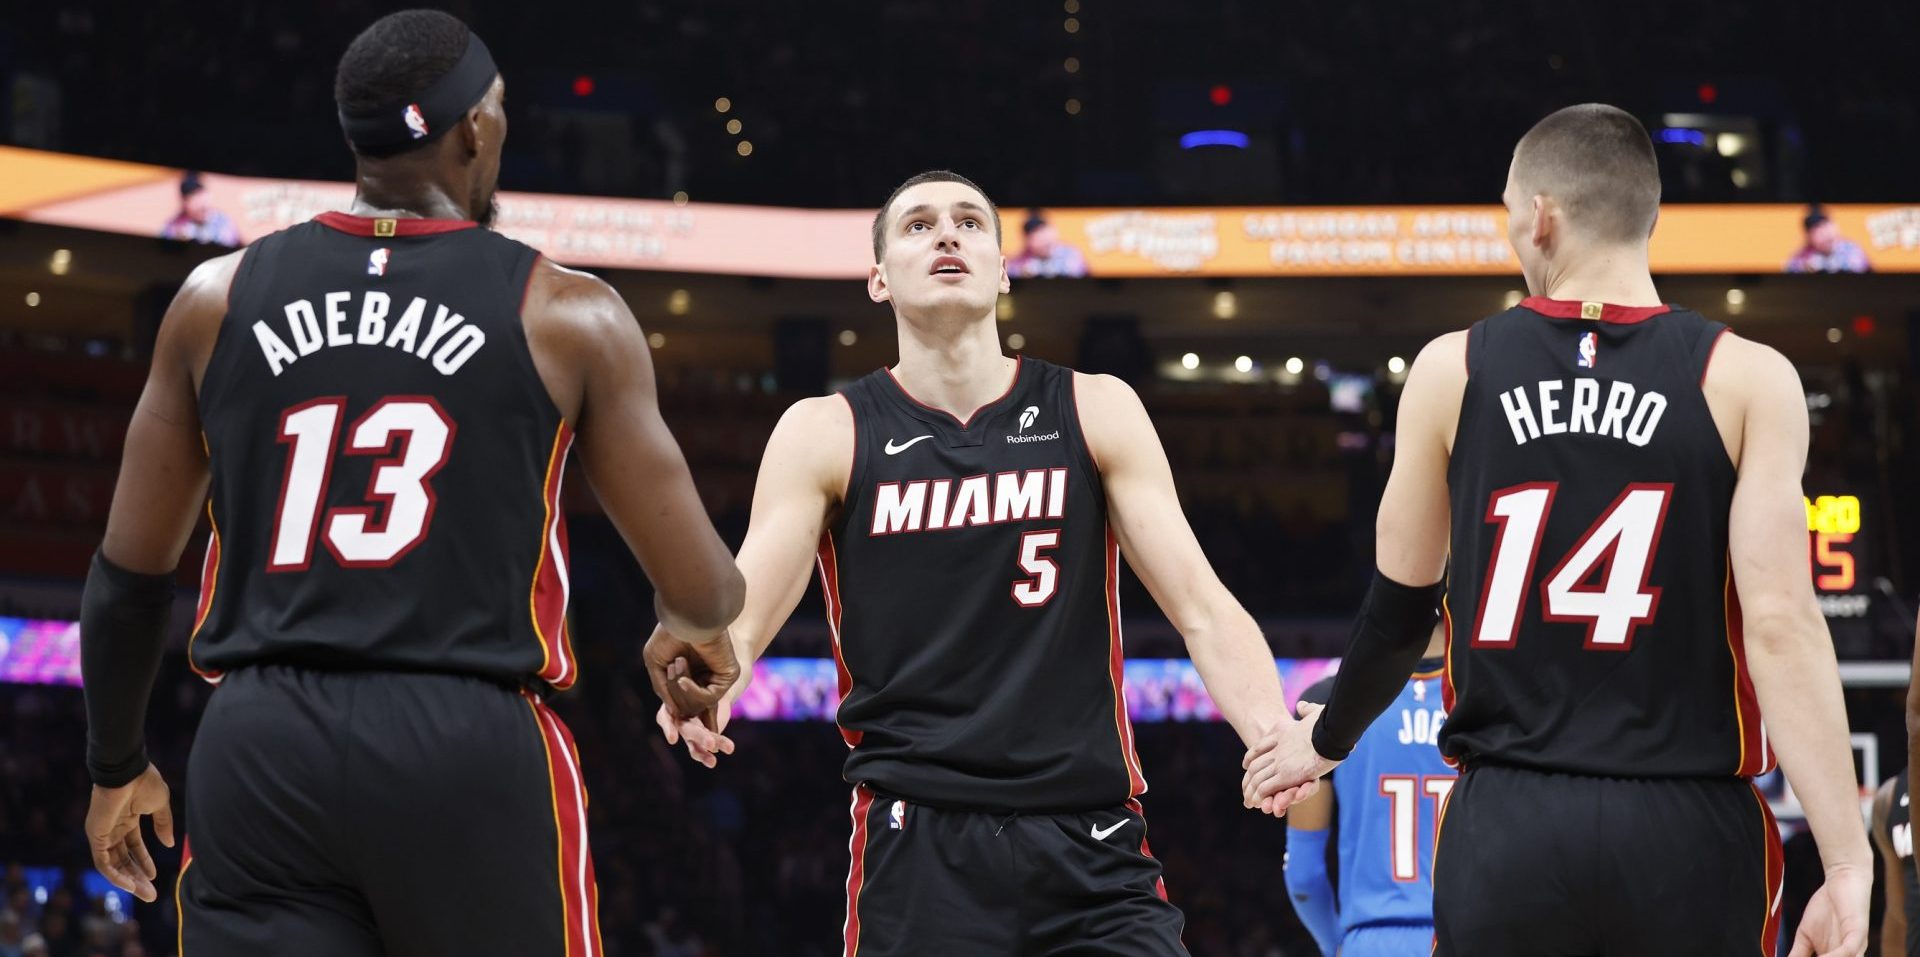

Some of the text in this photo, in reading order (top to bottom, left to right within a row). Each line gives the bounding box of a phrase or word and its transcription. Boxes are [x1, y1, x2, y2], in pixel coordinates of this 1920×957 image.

[252, 291, 486, 377] ADEBAYO
[1006, 430, 1060, 444] Robinhood
[1500, 378, 1668, 447] HERRO
[267, 396, 457, 573] 13
[870, 468, 1067, 537] MIAMI
[1011, 529, 1061, 608] 5
[1472, 483, 1674, 651] 14
[1809, 531, 1855, 590] 5
